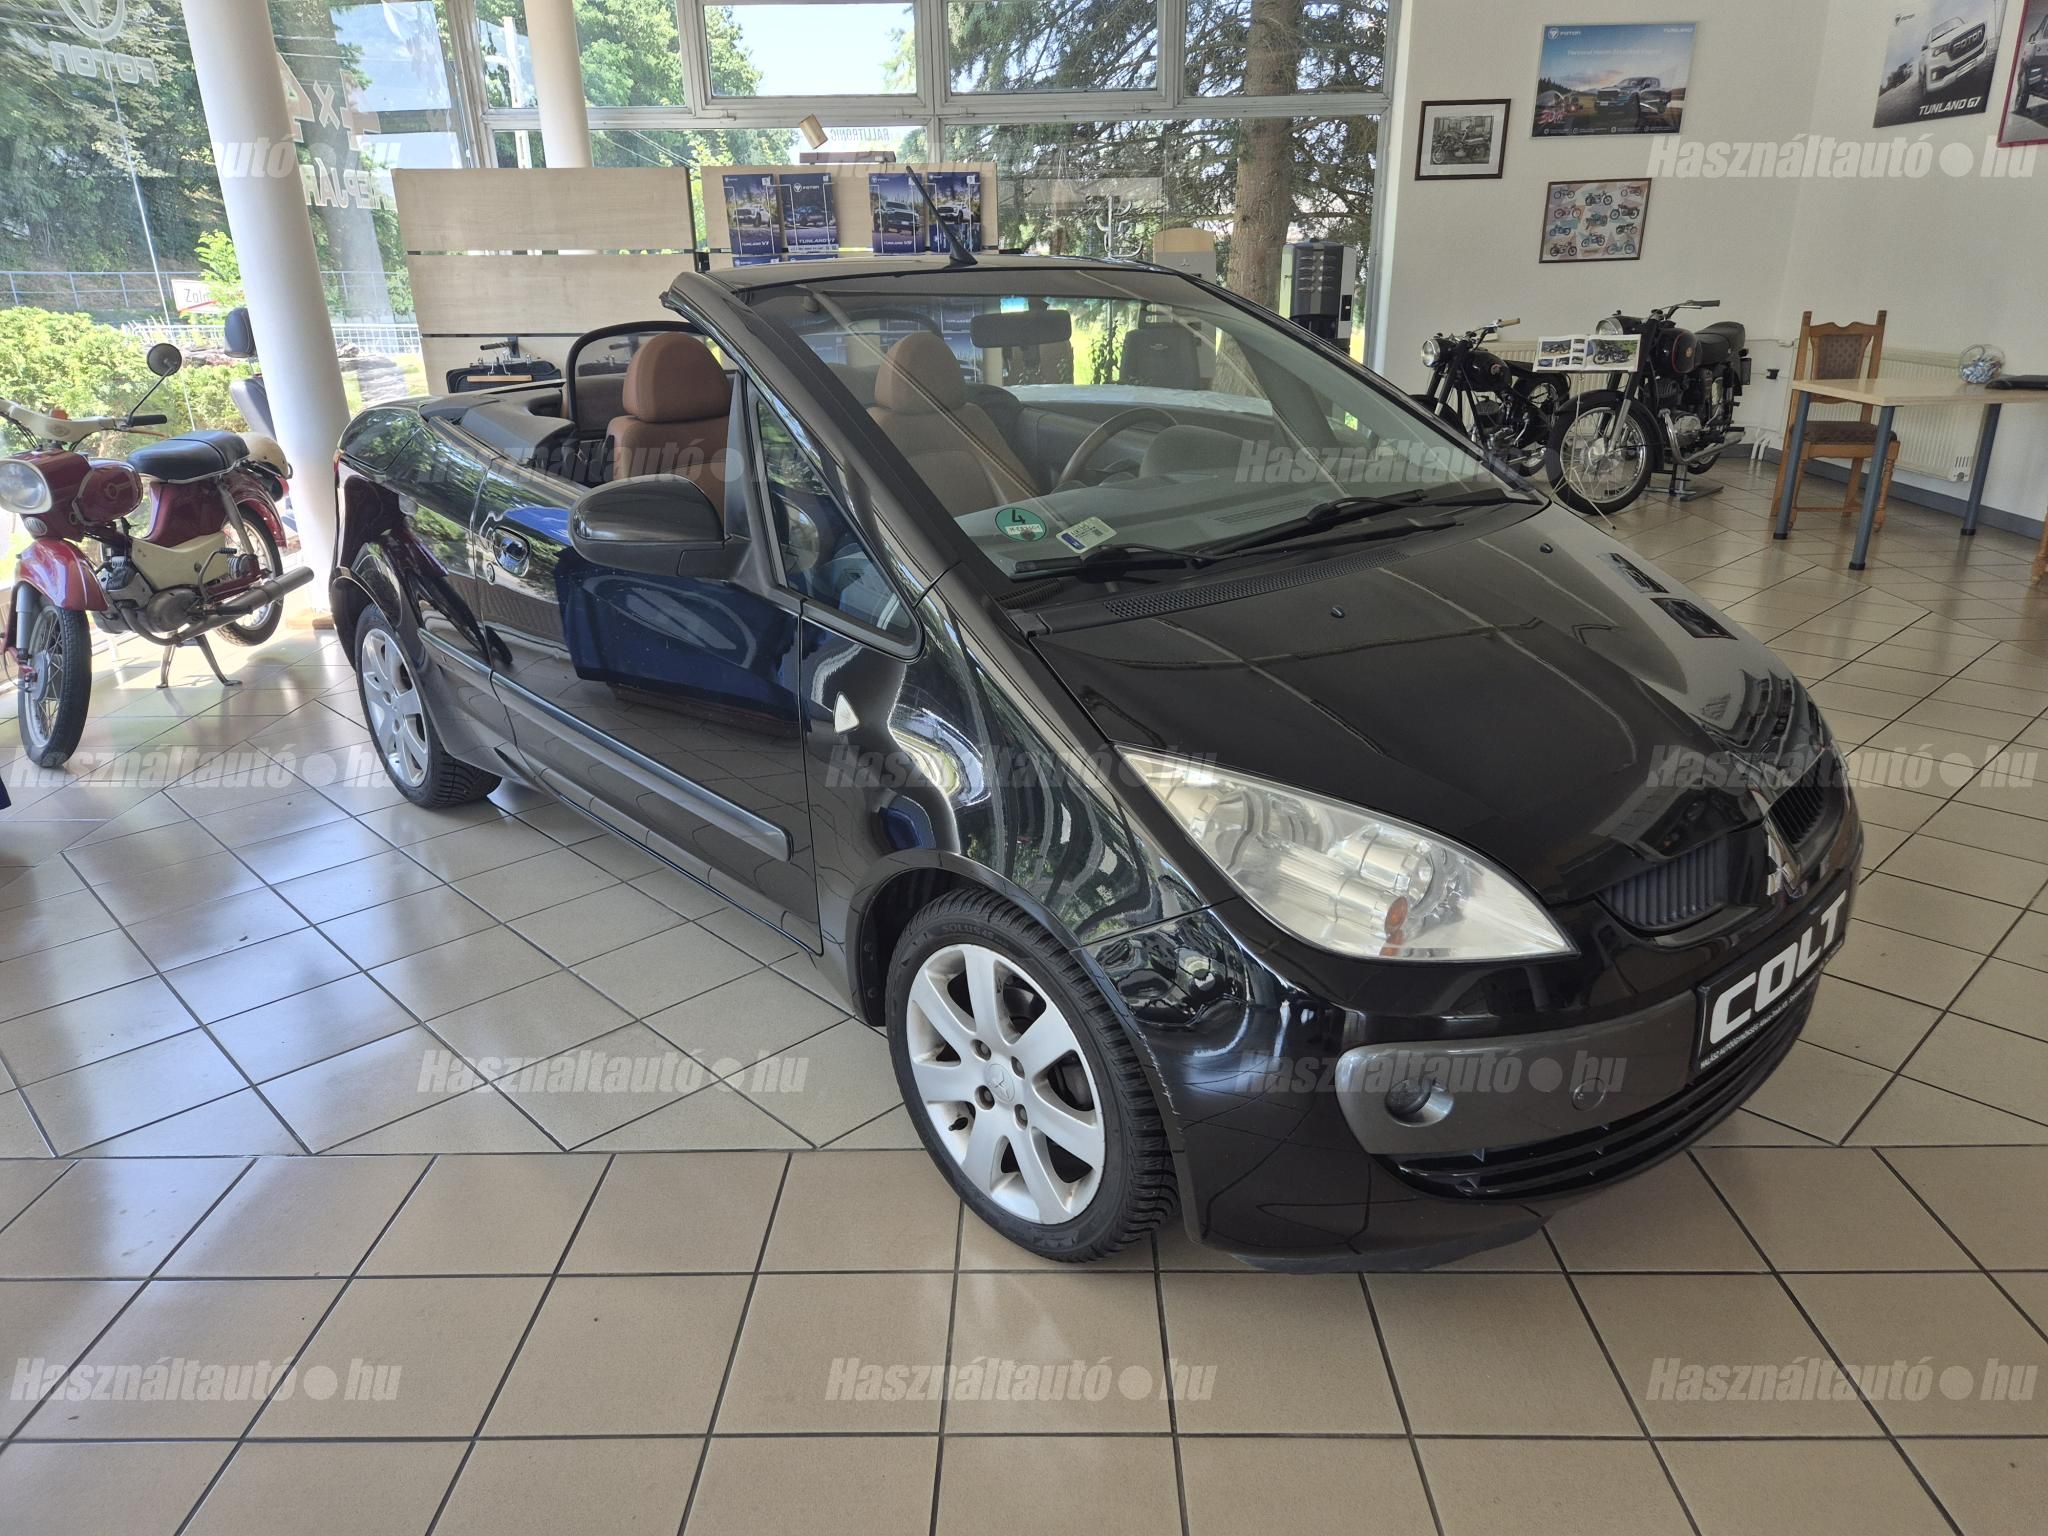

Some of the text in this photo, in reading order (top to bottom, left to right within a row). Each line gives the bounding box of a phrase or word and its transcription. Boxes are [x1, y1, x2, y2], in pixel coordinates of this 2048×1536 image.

[1918, 99, 1967, 116] TUNLAND
[1011, 509, 1026, 524] 4
[941, 923, 980, 936] SOLUS
[1709, 889, 1847, 1045] COLT
